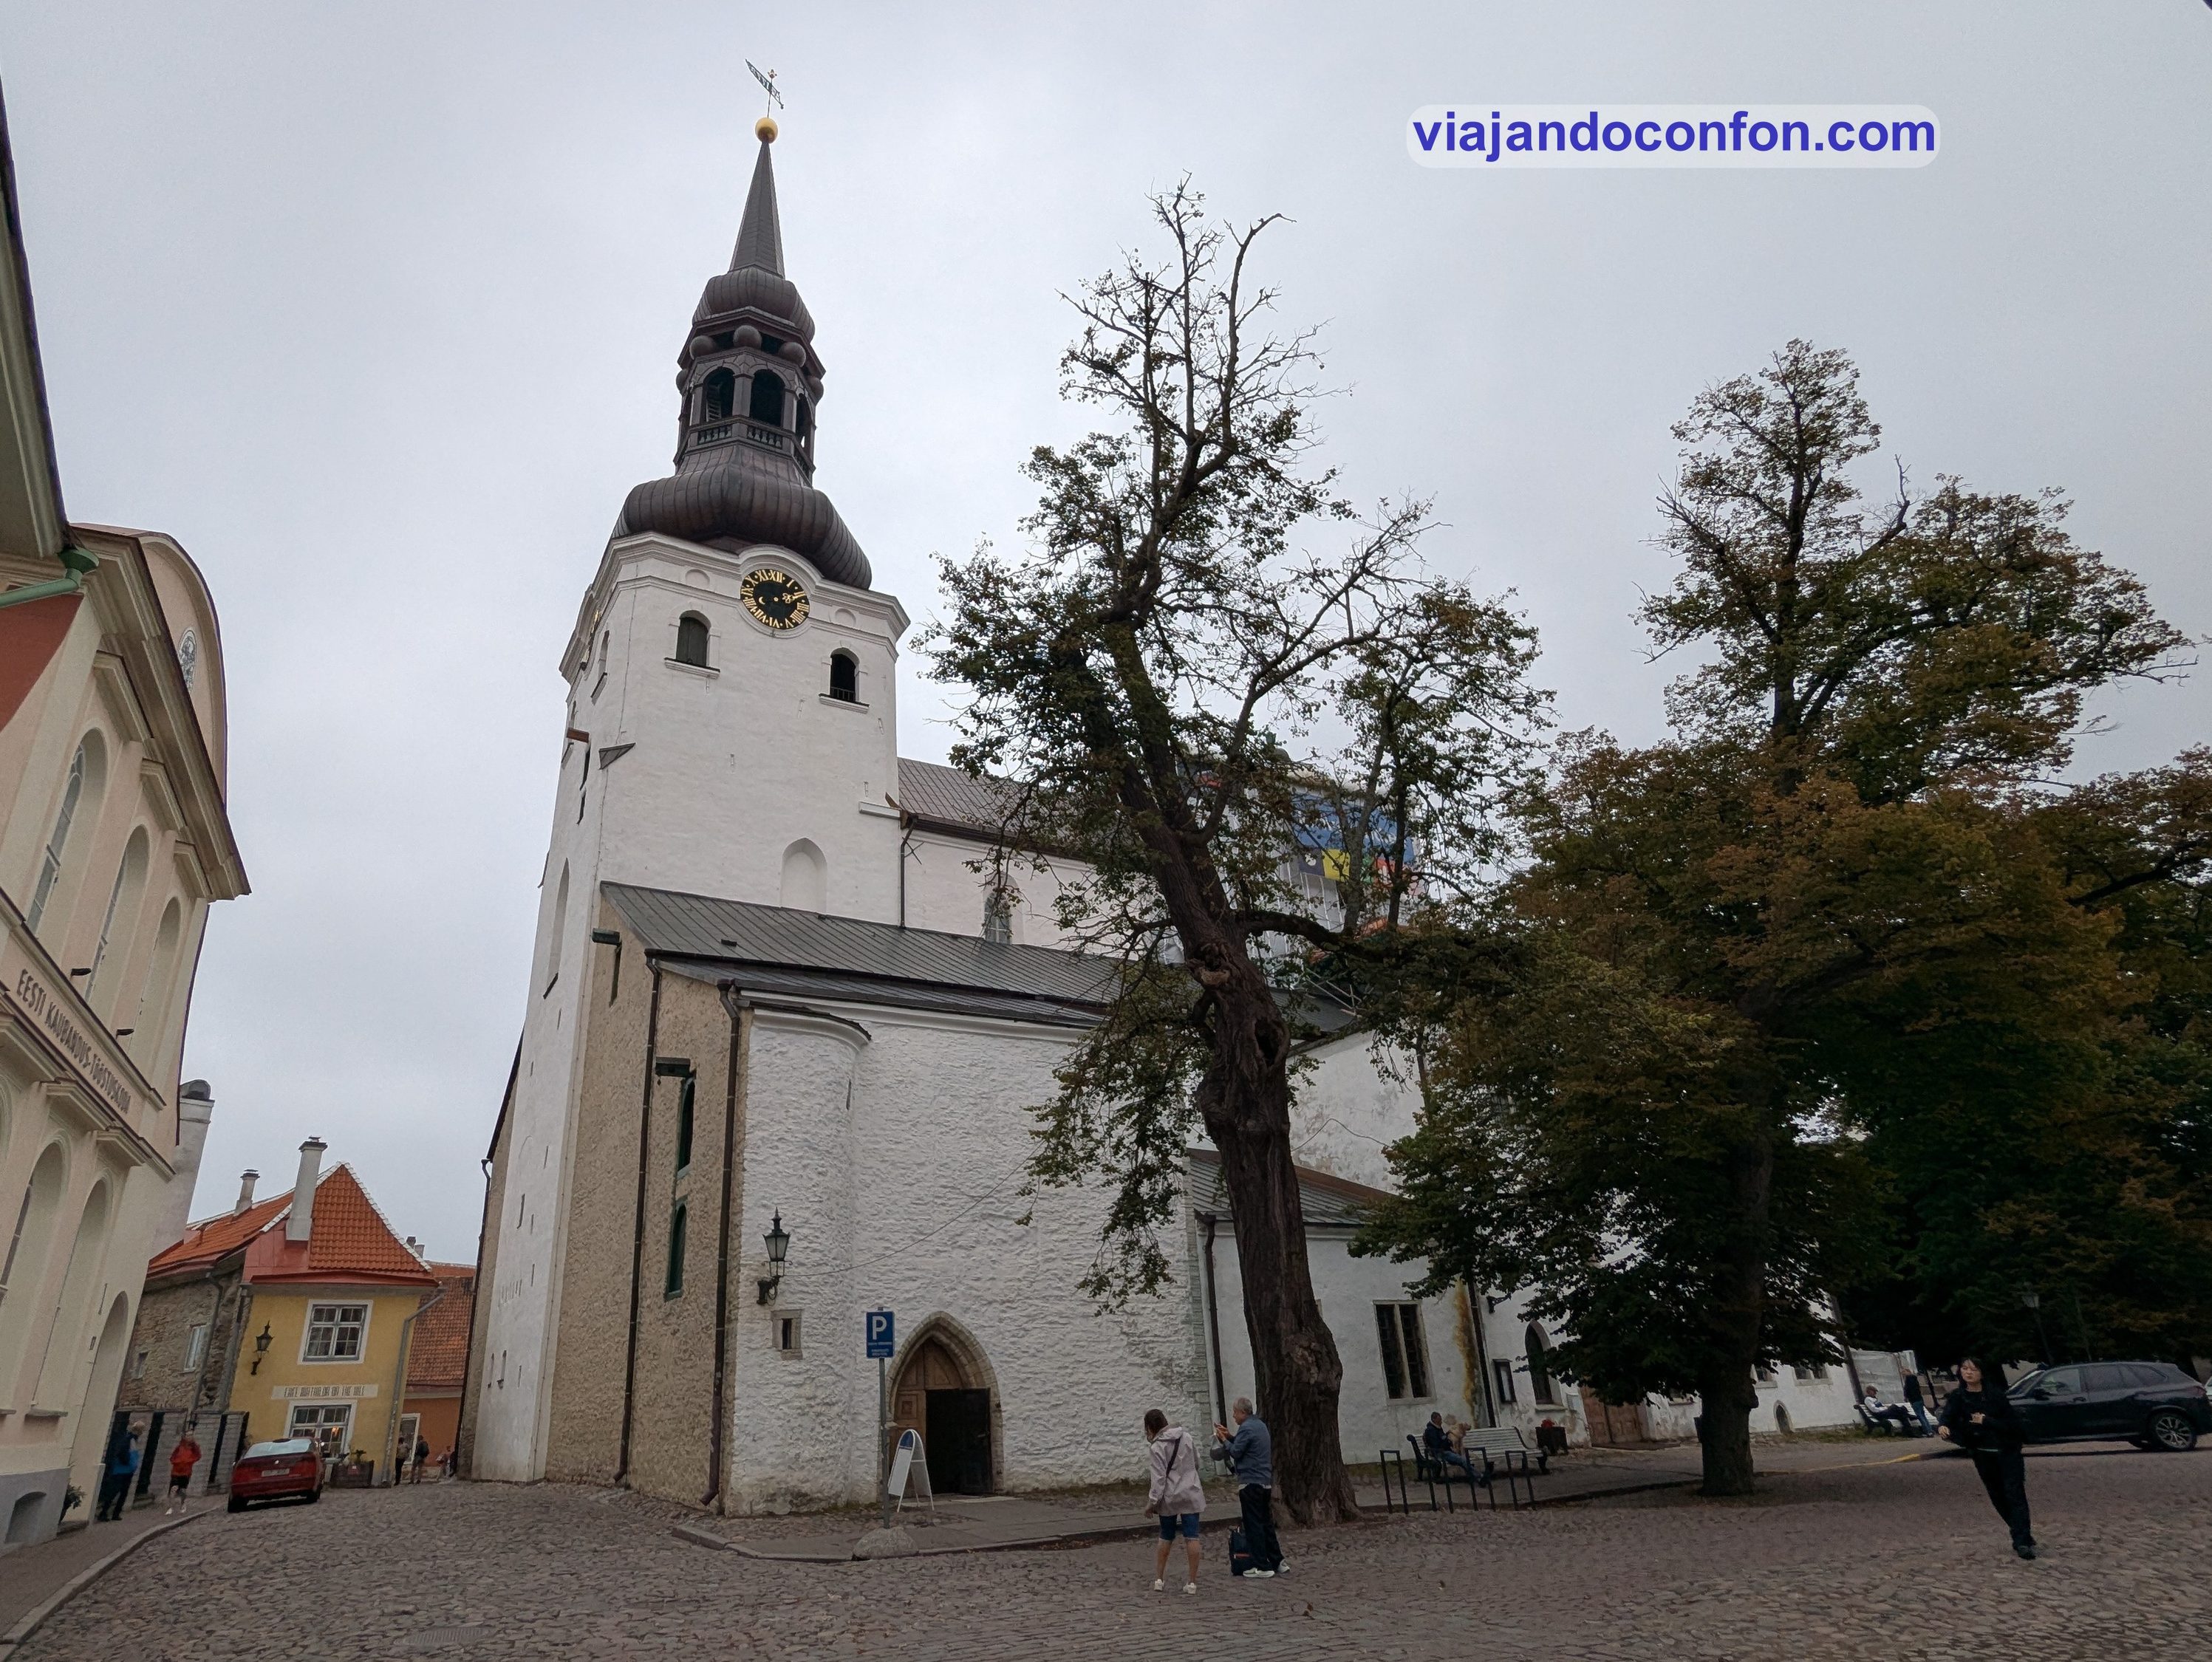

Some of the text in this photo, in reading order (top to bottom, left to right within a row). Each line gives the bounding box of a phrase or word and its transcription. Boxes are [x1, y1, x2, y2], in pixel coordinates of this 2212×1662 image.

[769, 570, 782, 583] XII
[16, 968, 47, 1016] EESTI
[872, 1316, 887, 1340] P
